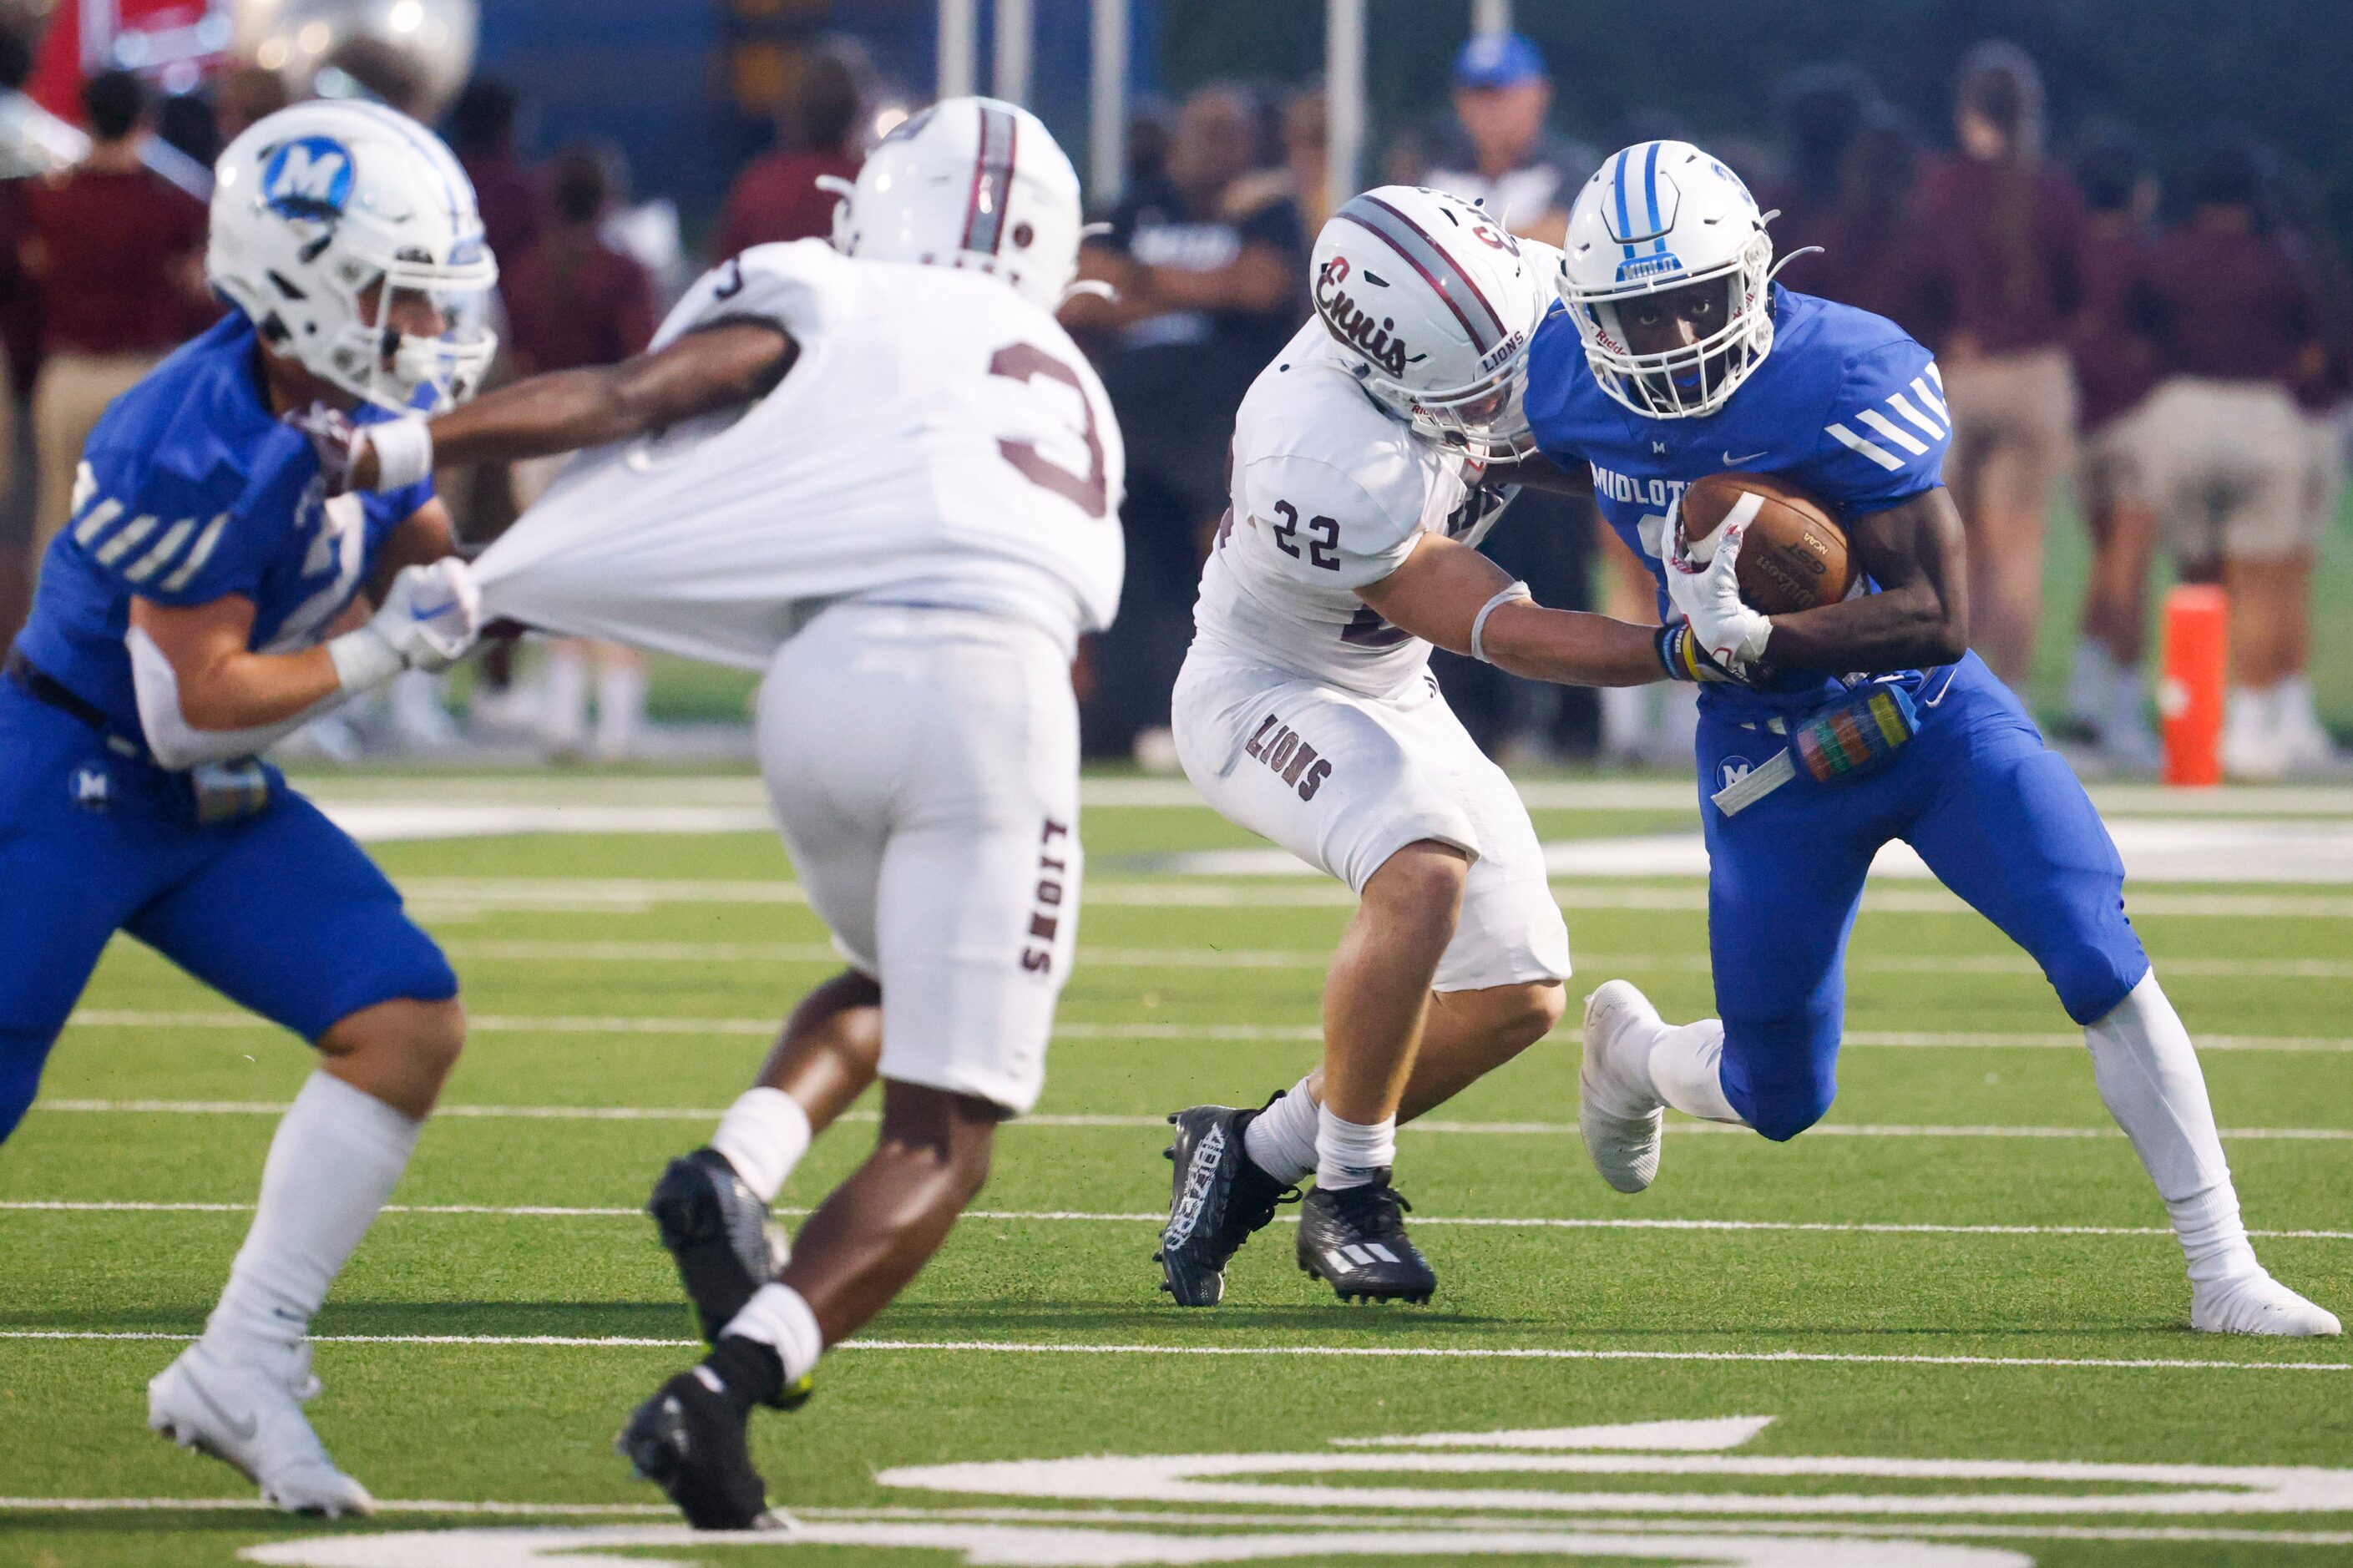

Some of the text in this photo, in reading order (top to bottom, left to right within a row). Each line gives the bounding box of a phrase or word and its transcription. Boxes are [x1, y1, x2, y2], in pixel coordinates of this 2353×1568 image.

[271, 144, 345, 200] M
[1622, 255, 1674, 281] MIDLO
[1315, 255, 1406, 374] Ennis
[1481, 331, 1524, 373] LIONS
[989, 341, 1107, 520] 3
[1652, 441, 1666, 453] M
[1589, 459, 1692, 507] MIDLOT
[1273, 499, 1340, 571] 22
[1804, 532, 1829, 555] NCAA
[1755, 554, 1816, 607] Wilson
[1245, 713, 1332, 802] LIONS
[1723, 764, 1748, 788] M
[79, 770, 107, 799] M
[1021, 818, 1068, 974] LIONS
